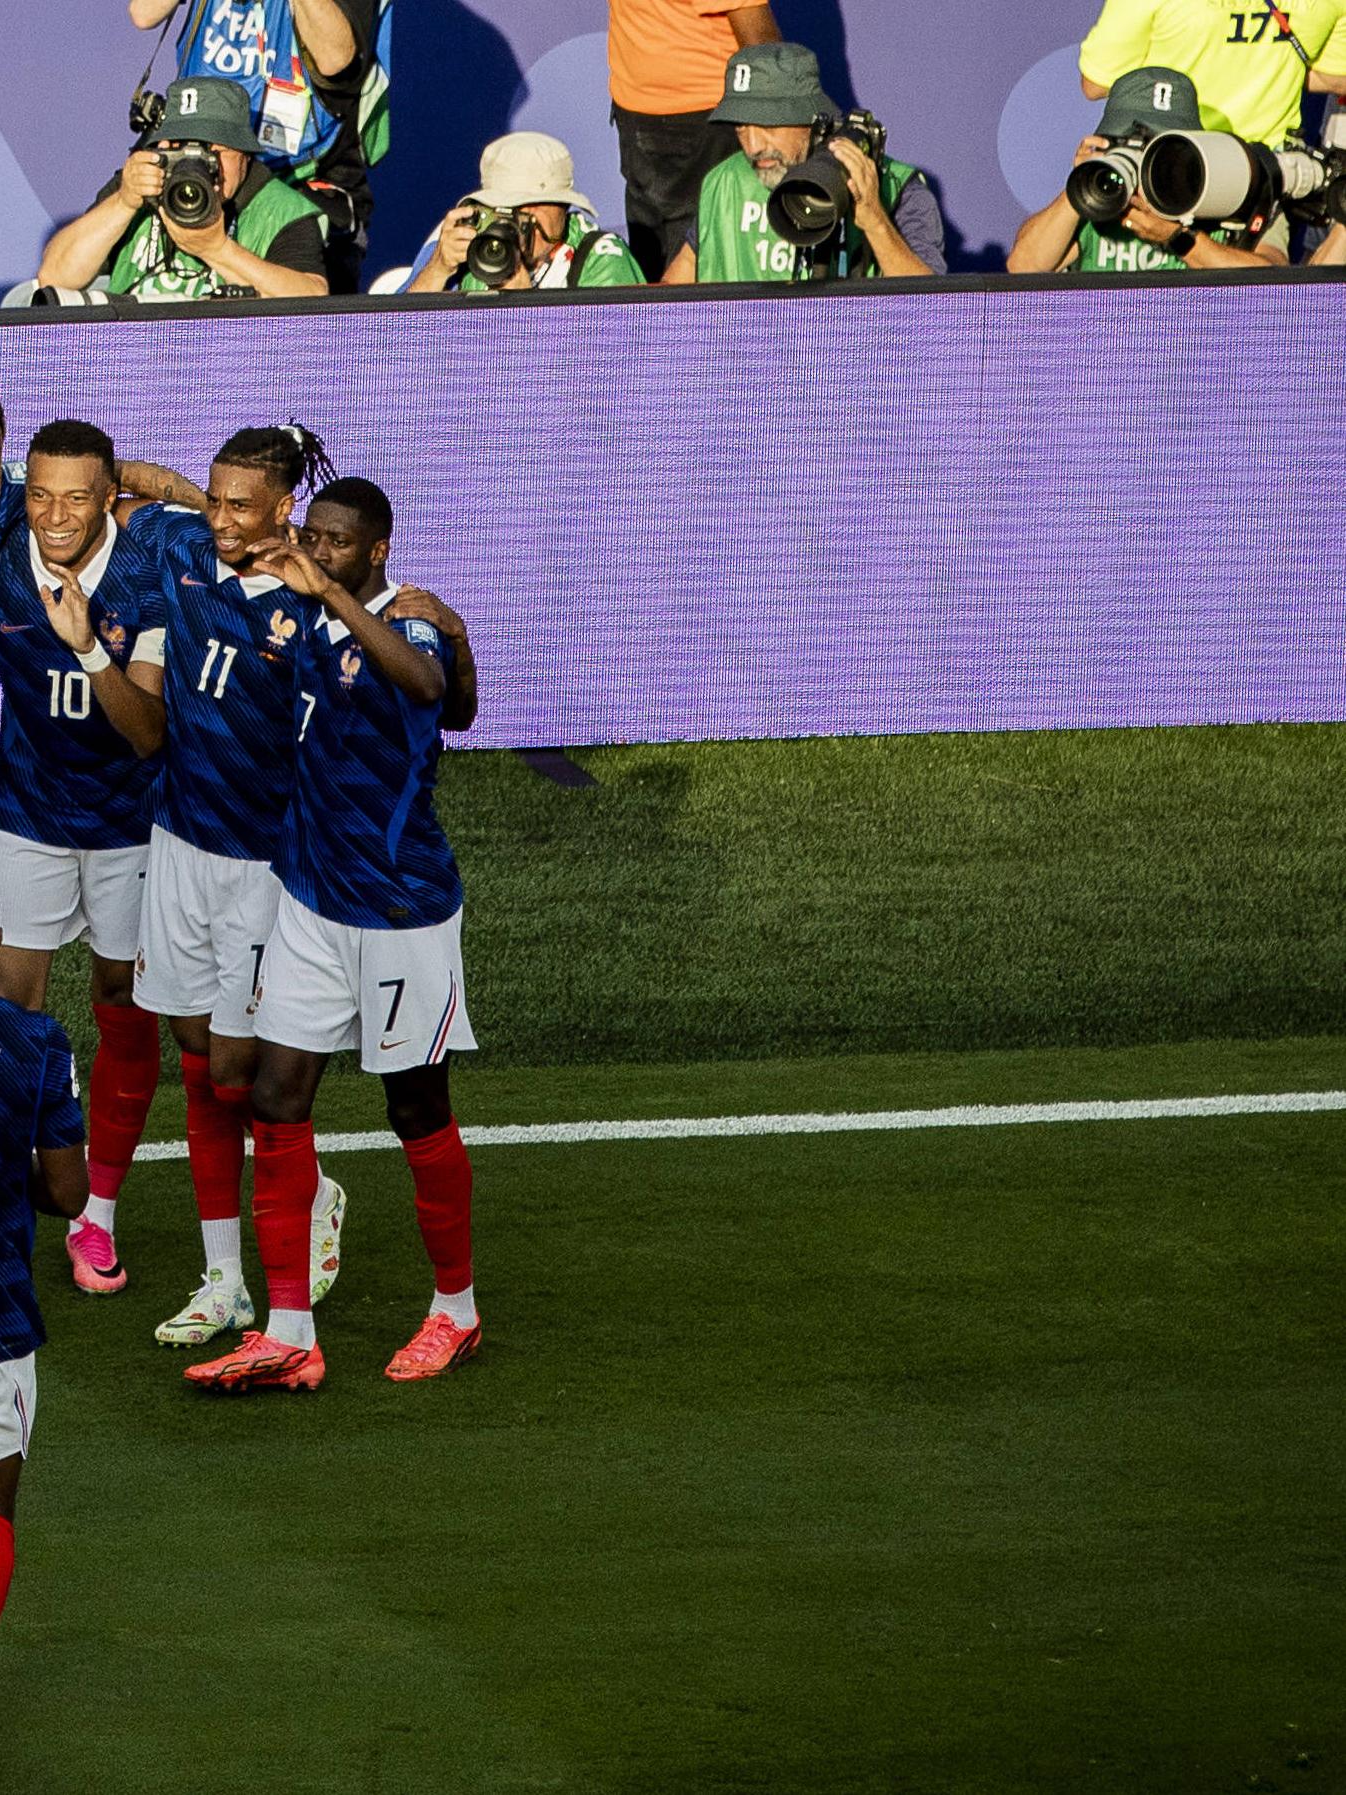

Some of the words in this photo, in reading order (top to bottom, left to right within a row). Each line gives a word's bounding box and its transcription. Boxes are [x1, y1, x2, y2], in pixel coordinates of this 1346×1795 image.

[1097, 236, 1168, 272] PHO
[47, 668, 91, 720] 10
[197, 638, 238, 700] 11
[298, 690, 316, 743] 7
[379, 977, 406, 1032] 7
